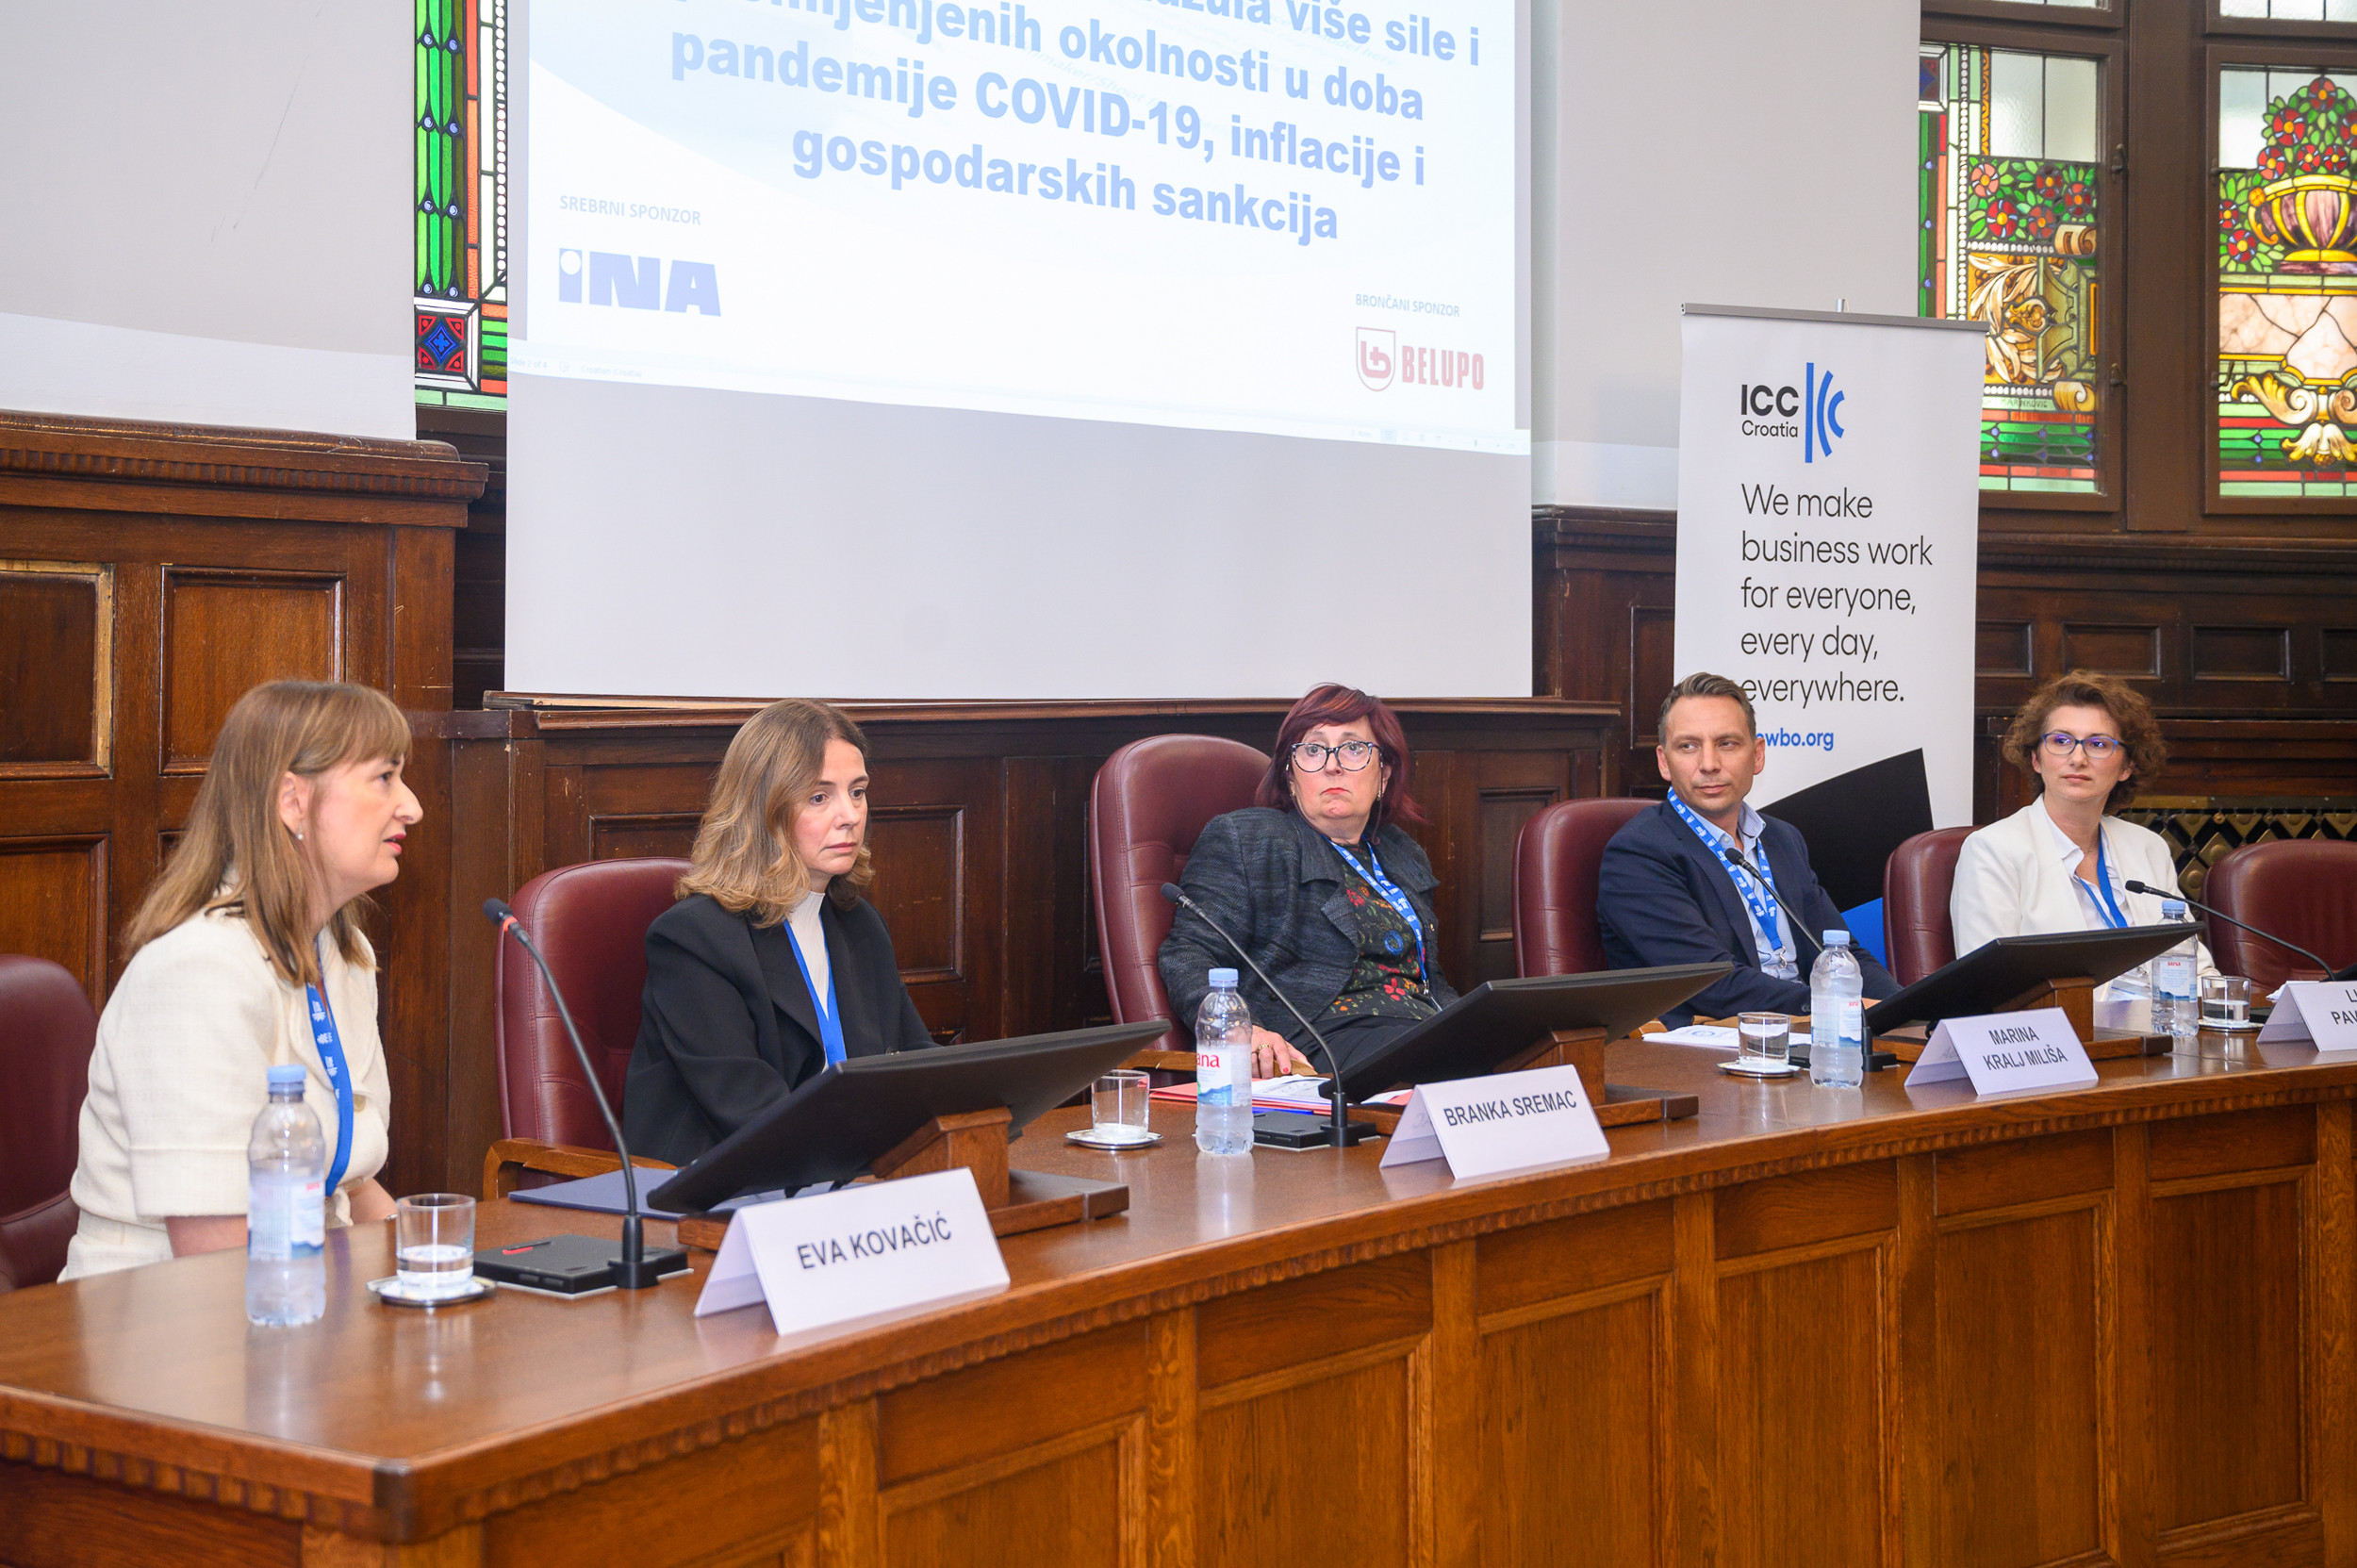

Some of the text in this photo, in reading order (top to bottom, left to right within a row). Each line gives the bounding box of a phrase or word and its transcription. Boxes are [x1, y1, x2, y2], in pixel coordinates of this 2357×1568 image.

[1286, 0, 1372, 45] više
[1386, 14, 1457, 61] sile
[1471, 26, 1479, 67] i
[1060, 19, 1269, 92] okolnosti
[1286, 67, 1309, 99] u
[1325, 66, 1424, 121] doba
[673, 33, 1425, 190] pandemije COVID-19, inflacije i
[793, 130, 1338, 247] gospodarskih sankcija
[559, 194, 701, 225] SREBRNI SPONZOR
[1356, 293, 1460, 318] BRONČANI SPONZOR
[534, 360, 541, 370] of
[1402, 345, 1484, 390] BELUPO
[1741, 384, 1800, 418] ICC
[1742, 420, 1799, 438] Croatia
[1741, 484, 1873, 519] We make
[1741, 531, 1933, 566] business work
[1740, 577, 1916, 618] for everyone,
[1740, 625, 1878, 664] every day,
[1742, 670, 1904, 709] everywhere.
[1988, 1026, 2041, 1046] MARINA
[1196, 1052, 1221, 1068] ana
[1983, 1044, 2069, 1071] KRALJ MILIŠA
[1443, 1090, 1577, 1127] BRANKA SREMAC
[798, 1211, 952, 1270] EVA KOVAČIĆ
